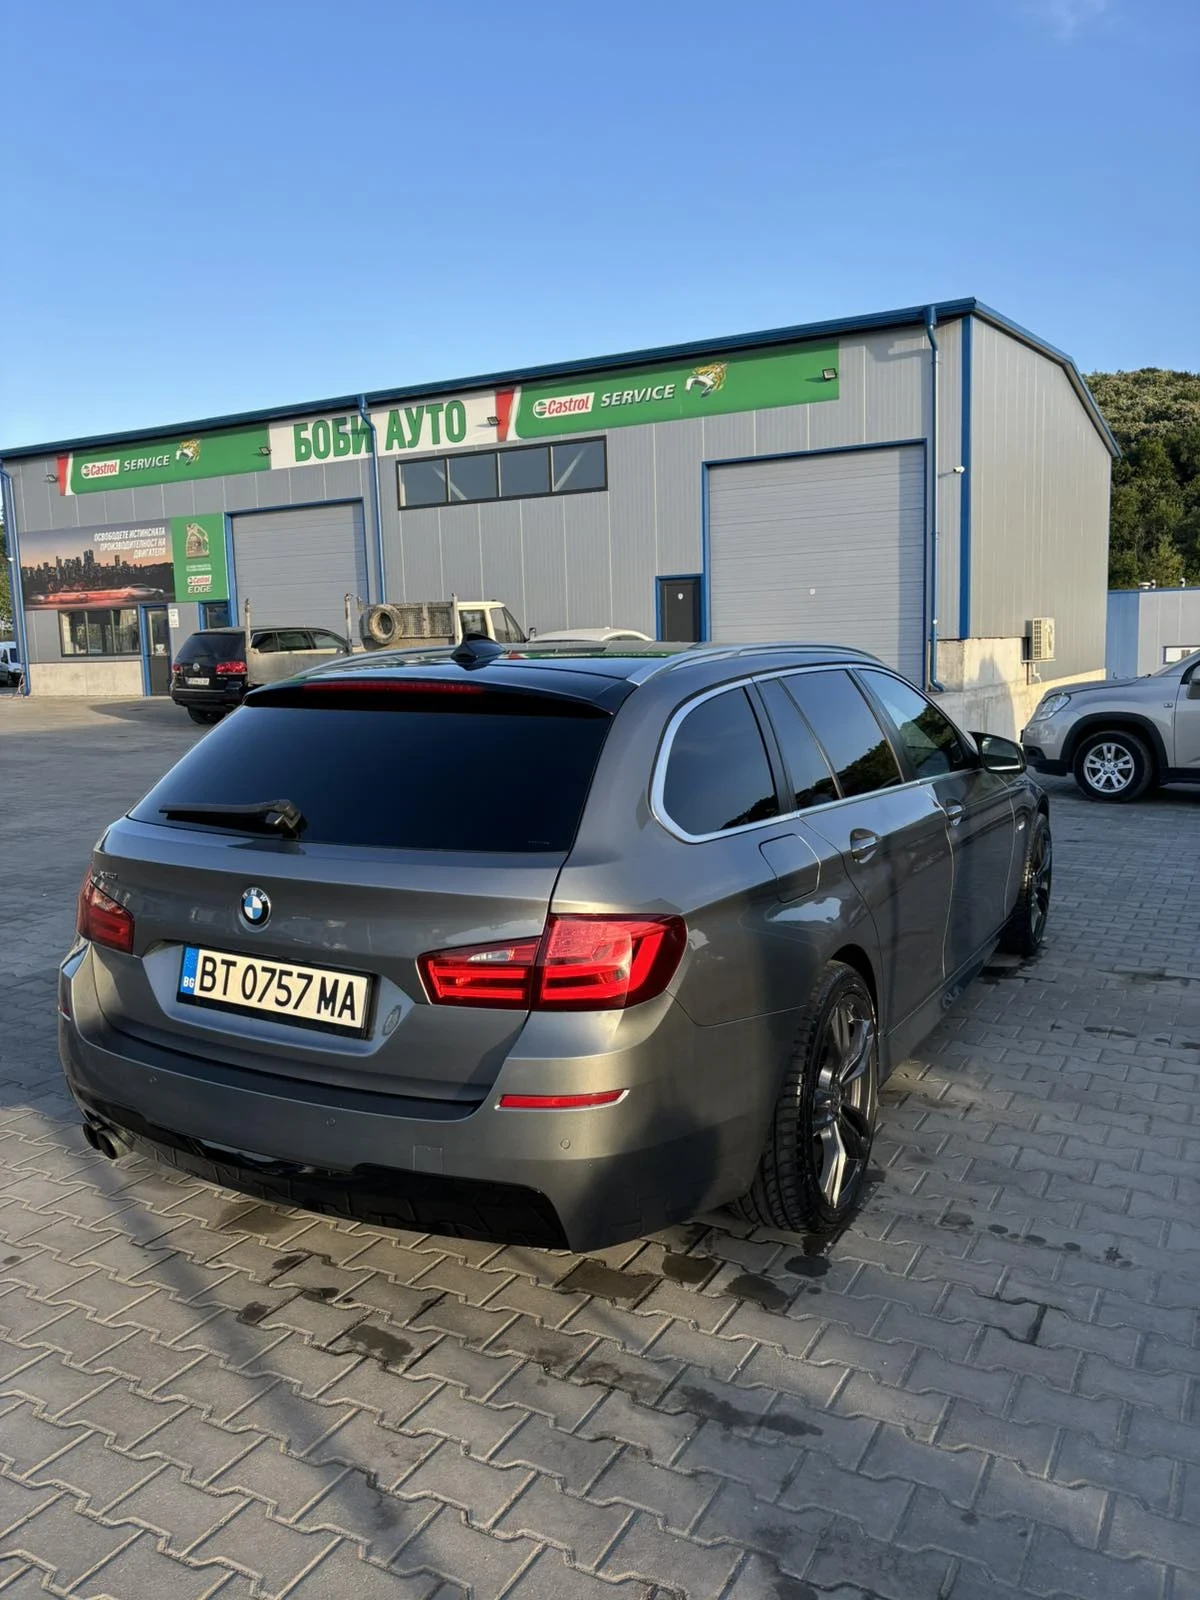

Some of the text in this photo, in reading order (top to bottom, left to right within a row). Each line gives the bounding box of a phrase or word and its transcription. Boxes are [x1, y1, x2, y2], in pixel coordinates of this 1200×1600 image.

[547, 384, 676, 415] Castrol SERVICE
[293, 399, 467, 462] БОБИ АУТО
[90, 455, 170, 477] Castrol SERVICE
[187, 585, 212, 594] EDGE
[183, 977, 195, 988] BG
[199, 956, 356, 1021] BT 0757 MA
